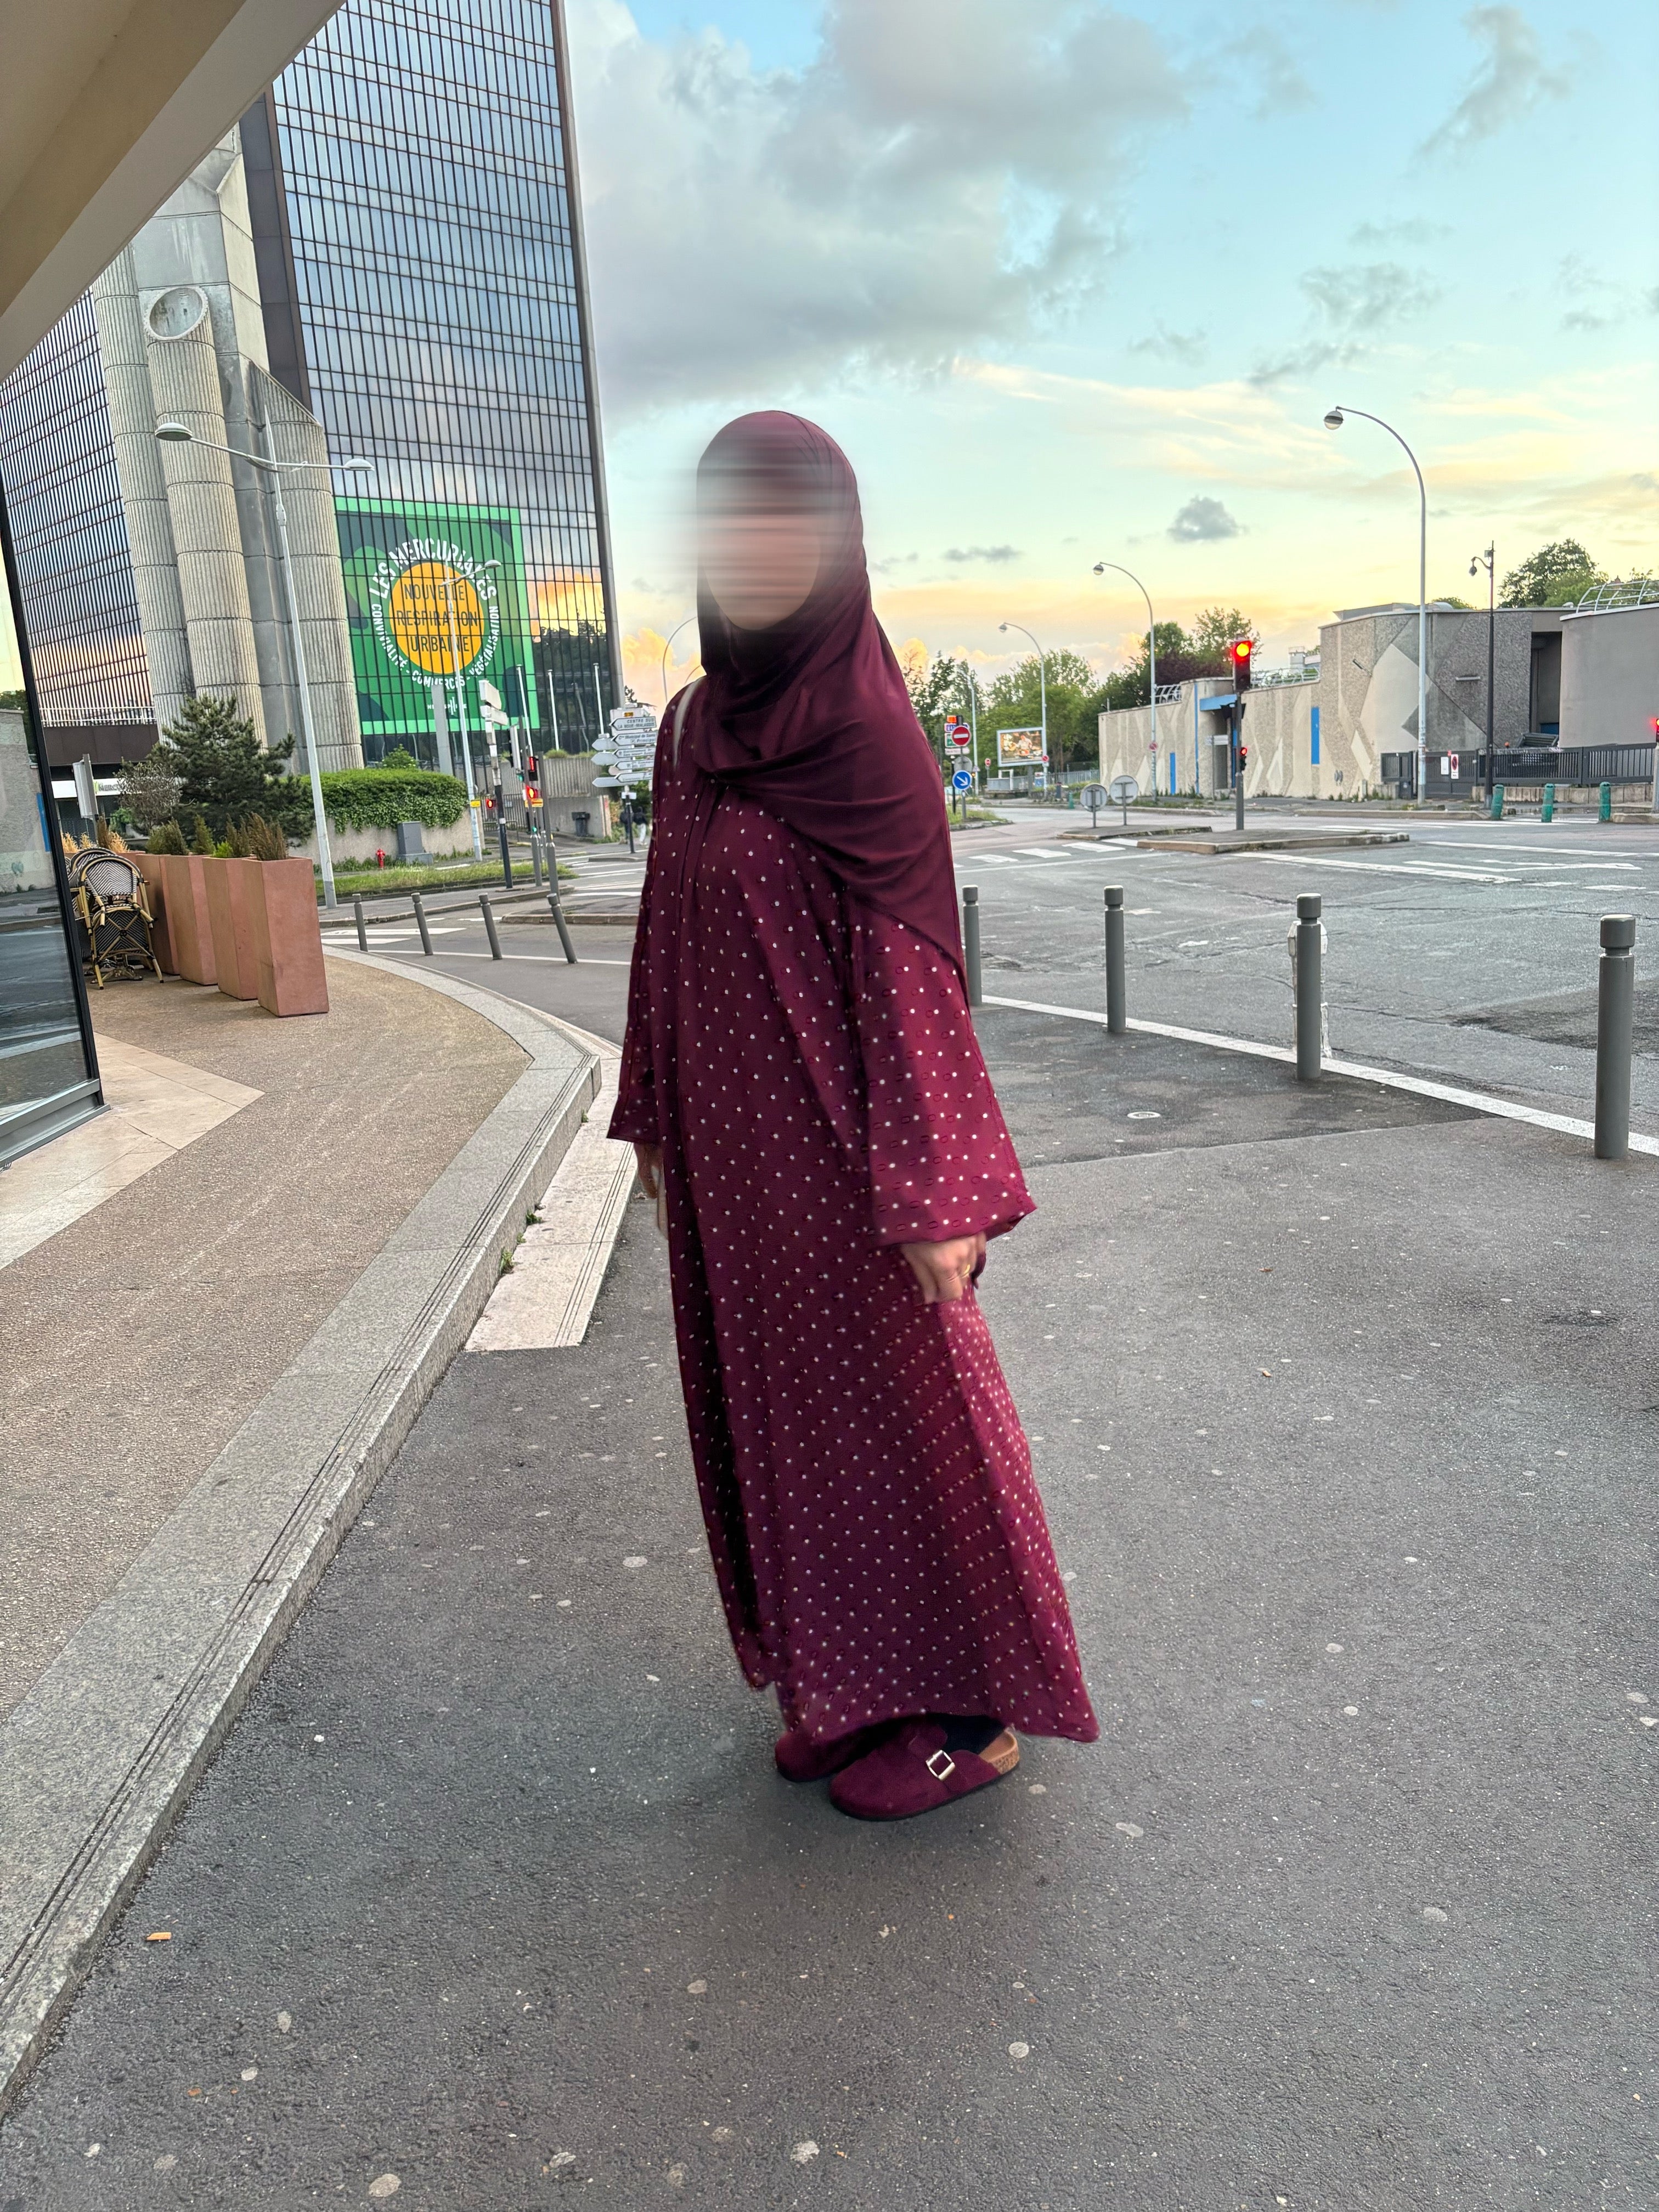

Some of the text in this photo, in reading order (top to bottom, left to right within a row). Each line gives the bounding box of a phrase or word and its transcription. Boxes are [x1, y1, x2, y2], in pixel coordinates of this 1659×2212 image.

[369, 538, 497, 601] LES MERCURIALES
[371, 603, 408, 671] CONVIVIALITÉ
[396, 610, 478, 627] RESPIRATON
